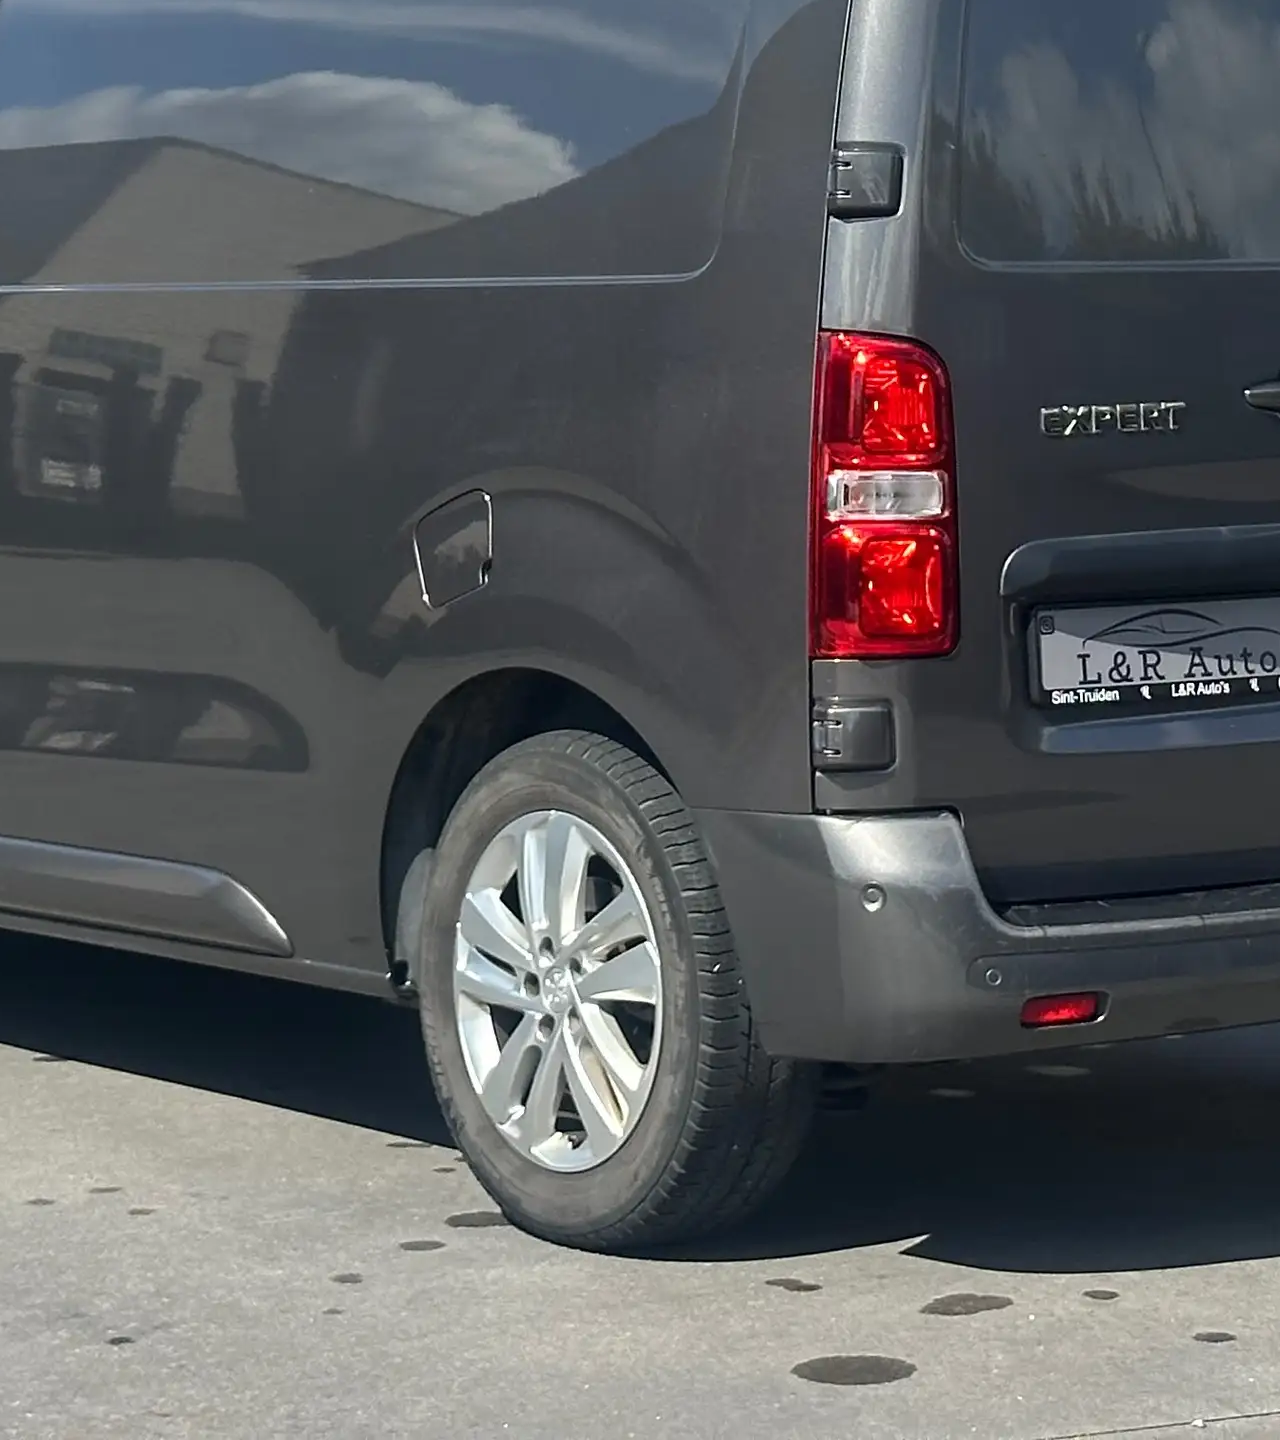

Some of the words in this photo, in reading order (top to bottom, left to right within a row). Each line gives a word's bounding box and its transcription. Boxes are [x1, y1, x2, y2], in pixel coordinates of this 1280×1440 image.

[1040, 402, 1186, 436] EXPERT
[1076, 648, 1166, 686] L&R
[1051, 688, 1120, 705] Sint-Truiden
[1171, 682, 1196, 697] L&R
[1197, 680, 1230, 695] Auto's
